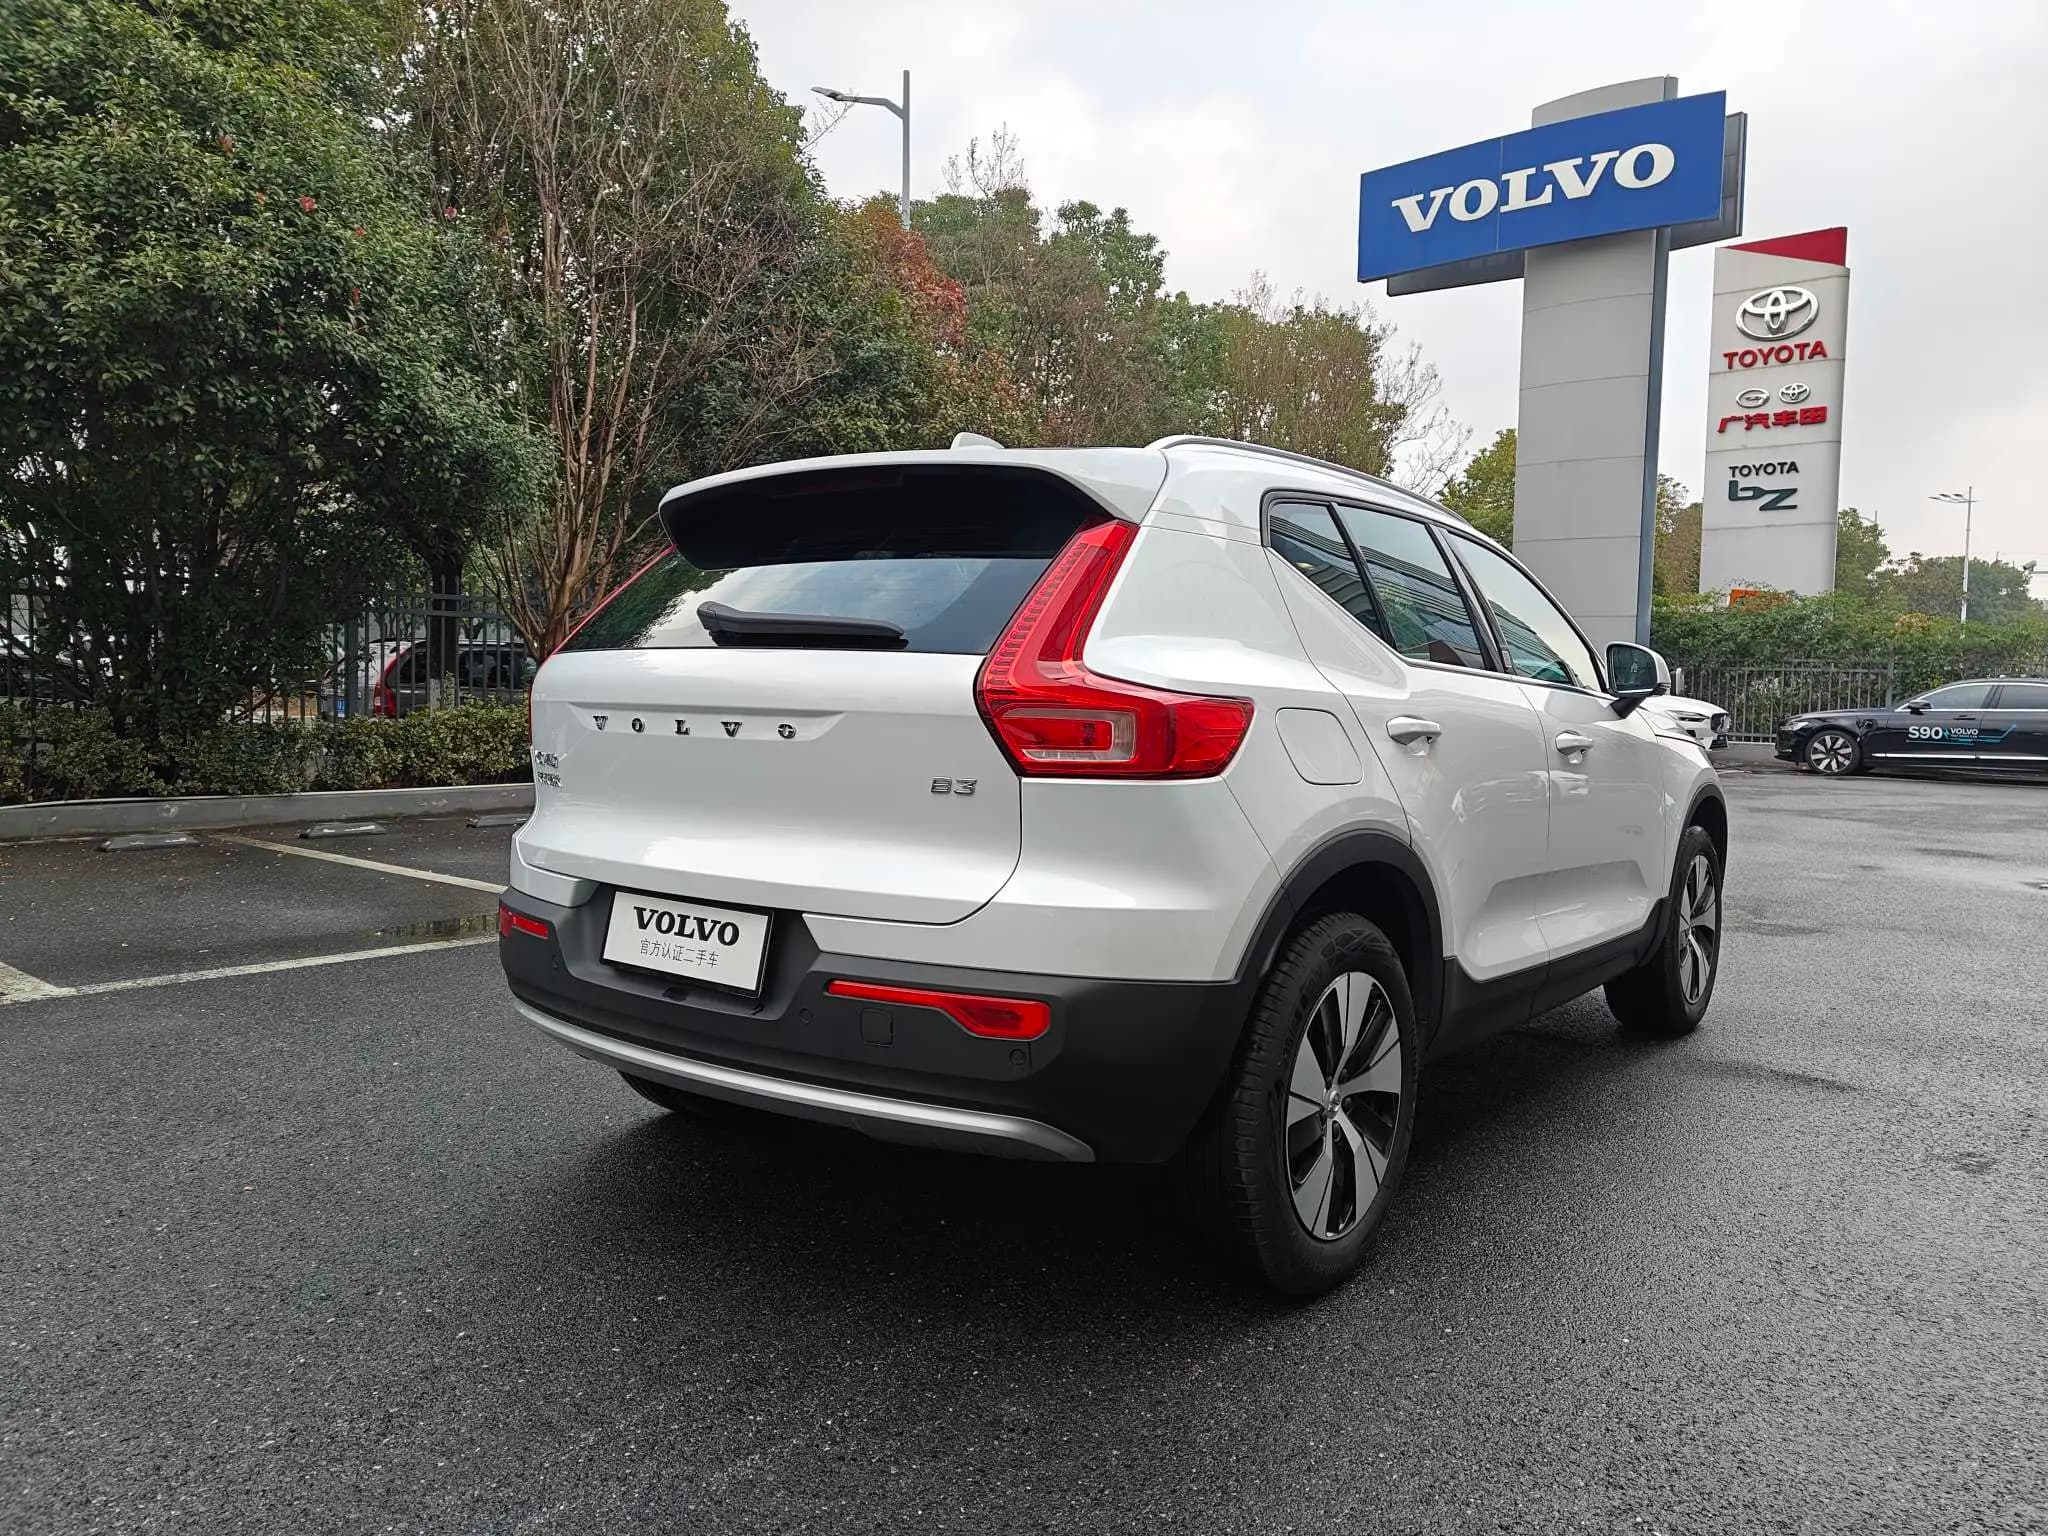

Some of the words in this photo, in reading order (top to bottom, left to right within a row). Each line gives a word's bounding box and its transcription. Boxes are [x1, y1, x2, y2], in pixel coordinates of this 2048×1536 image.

[1391, 143, 1675, 233] VOLVO
[1723, 340, 1828, 370] TOYOTA
[1717, 406, 1828, 433] 广汽丰田
[1728, 461, 1800, 478] TOYOTA
[592, 714, 797, 739] VOLVO
[1907, 725, 1943, 740] S90
[1950, 727, 1979, 736] VOLVO
[930, 776, 978, 796] B3
[633, 906, 740, 947] VOLVO
[640, 938, 720, 969] 官方认证二手车
